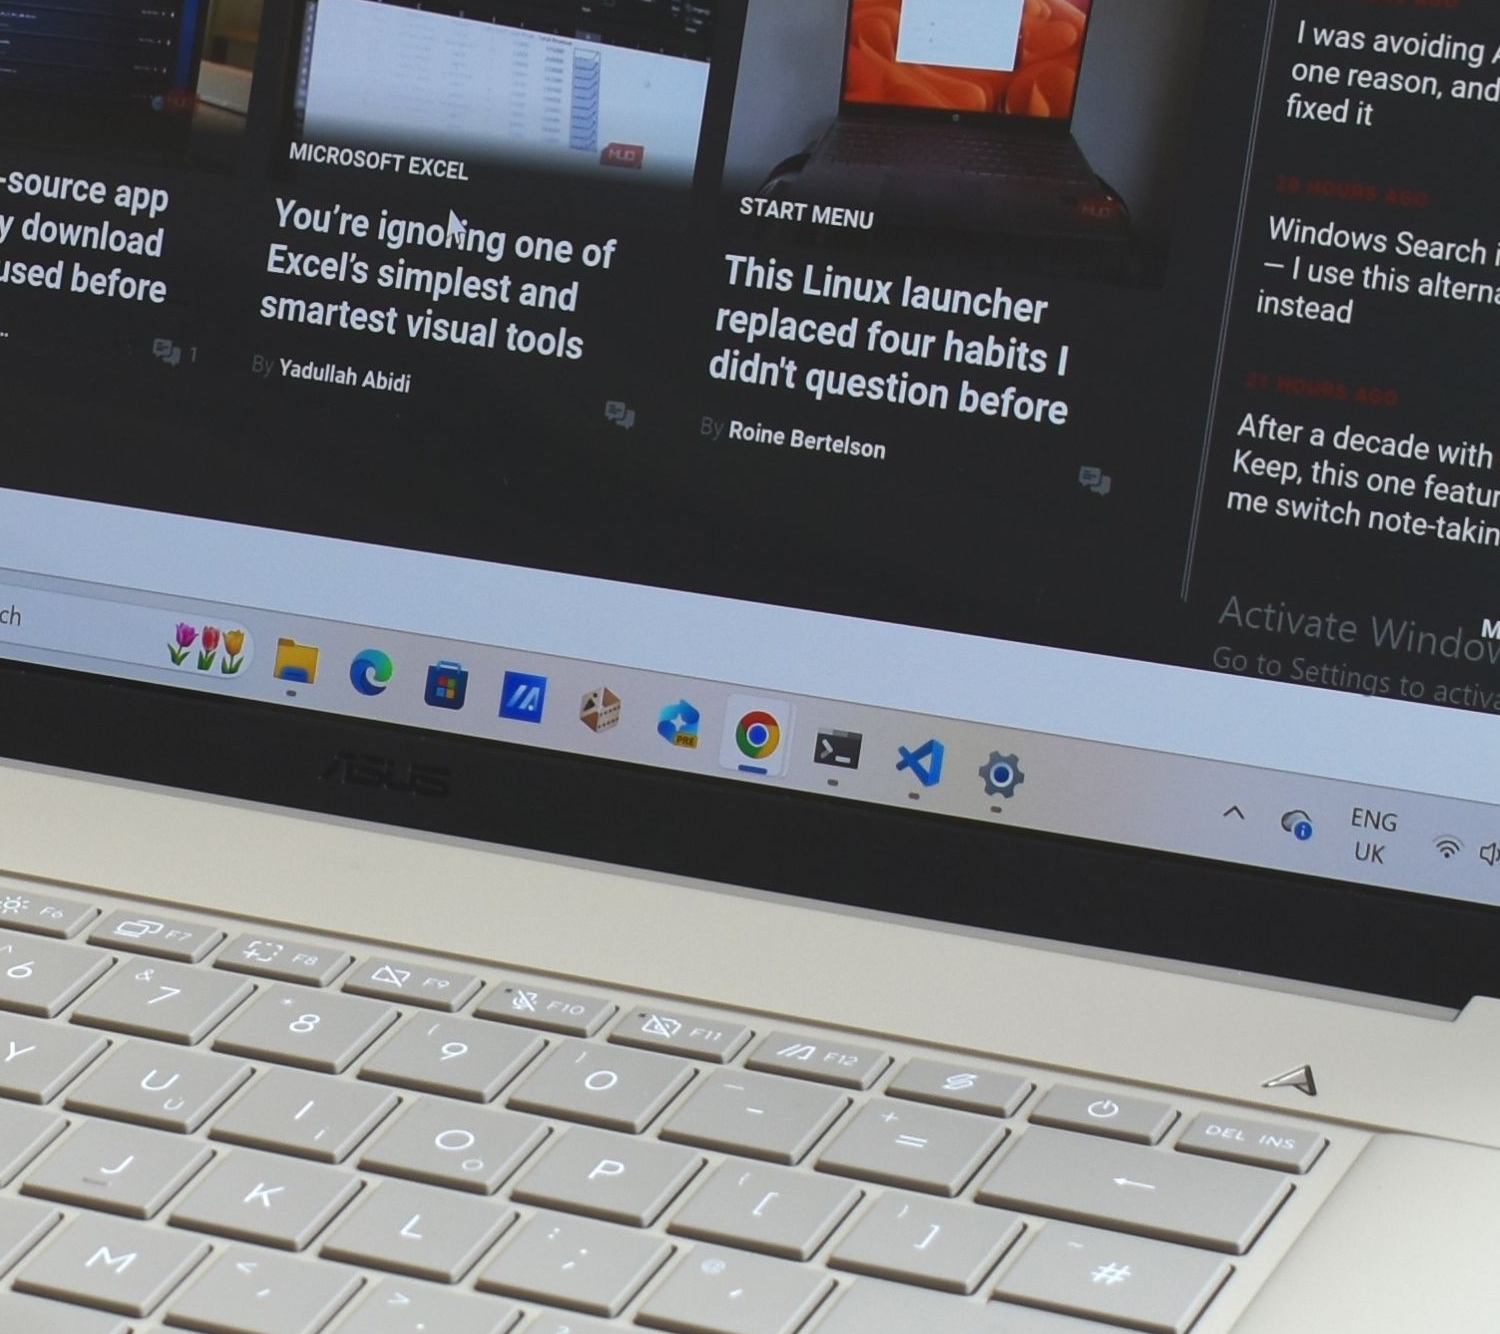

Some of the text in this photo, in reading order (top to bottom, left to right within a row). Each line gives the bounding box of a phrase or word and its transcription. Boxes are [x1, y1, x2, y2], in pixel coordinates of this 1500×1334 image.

[289, 141, 469, 181] MICROSOFT EXCEL
[514, 235, 574, 264] one
[581, 238, 618, 269] of
[377, 257, 512, 304] simplest
[518, 281, 579, 312] and
[259, 295, 584, 360] smartest visual tools
[251, 354, 412, 393] By Yadullah Abidi
[1236, 412, 1304, 443] After
[1309, 427, 1325, 447] a
[1333, 424, 1430, 463] decade
[1437, 441, 1493, 470] with
[1233, 448, 1303, 486] Keep,
[1311, 459, 1360, 489] this
[1366, 473, 1416, 497] one
[1227, 491, 1269, 514] me
[1275, 496, 1361, 527] switch
[1217, 594, 1358, 644] Activate
[1212, 645, 1249, 674] Go
[1256, 652, 1283, 677] to
[1290, 656, 1391, 696] Settings
[1399, 676, 1426, 699] to
[1351, 807, 1398, 833] ENG
[1355, 841, 1386, 865] UK
[546, 1000, 585, 1016] F10
[823, 1051, 859, 1067] F12
[1205, 1124, 1296, 1150] DEL INS
[85, 1246, 137, 1274] M
